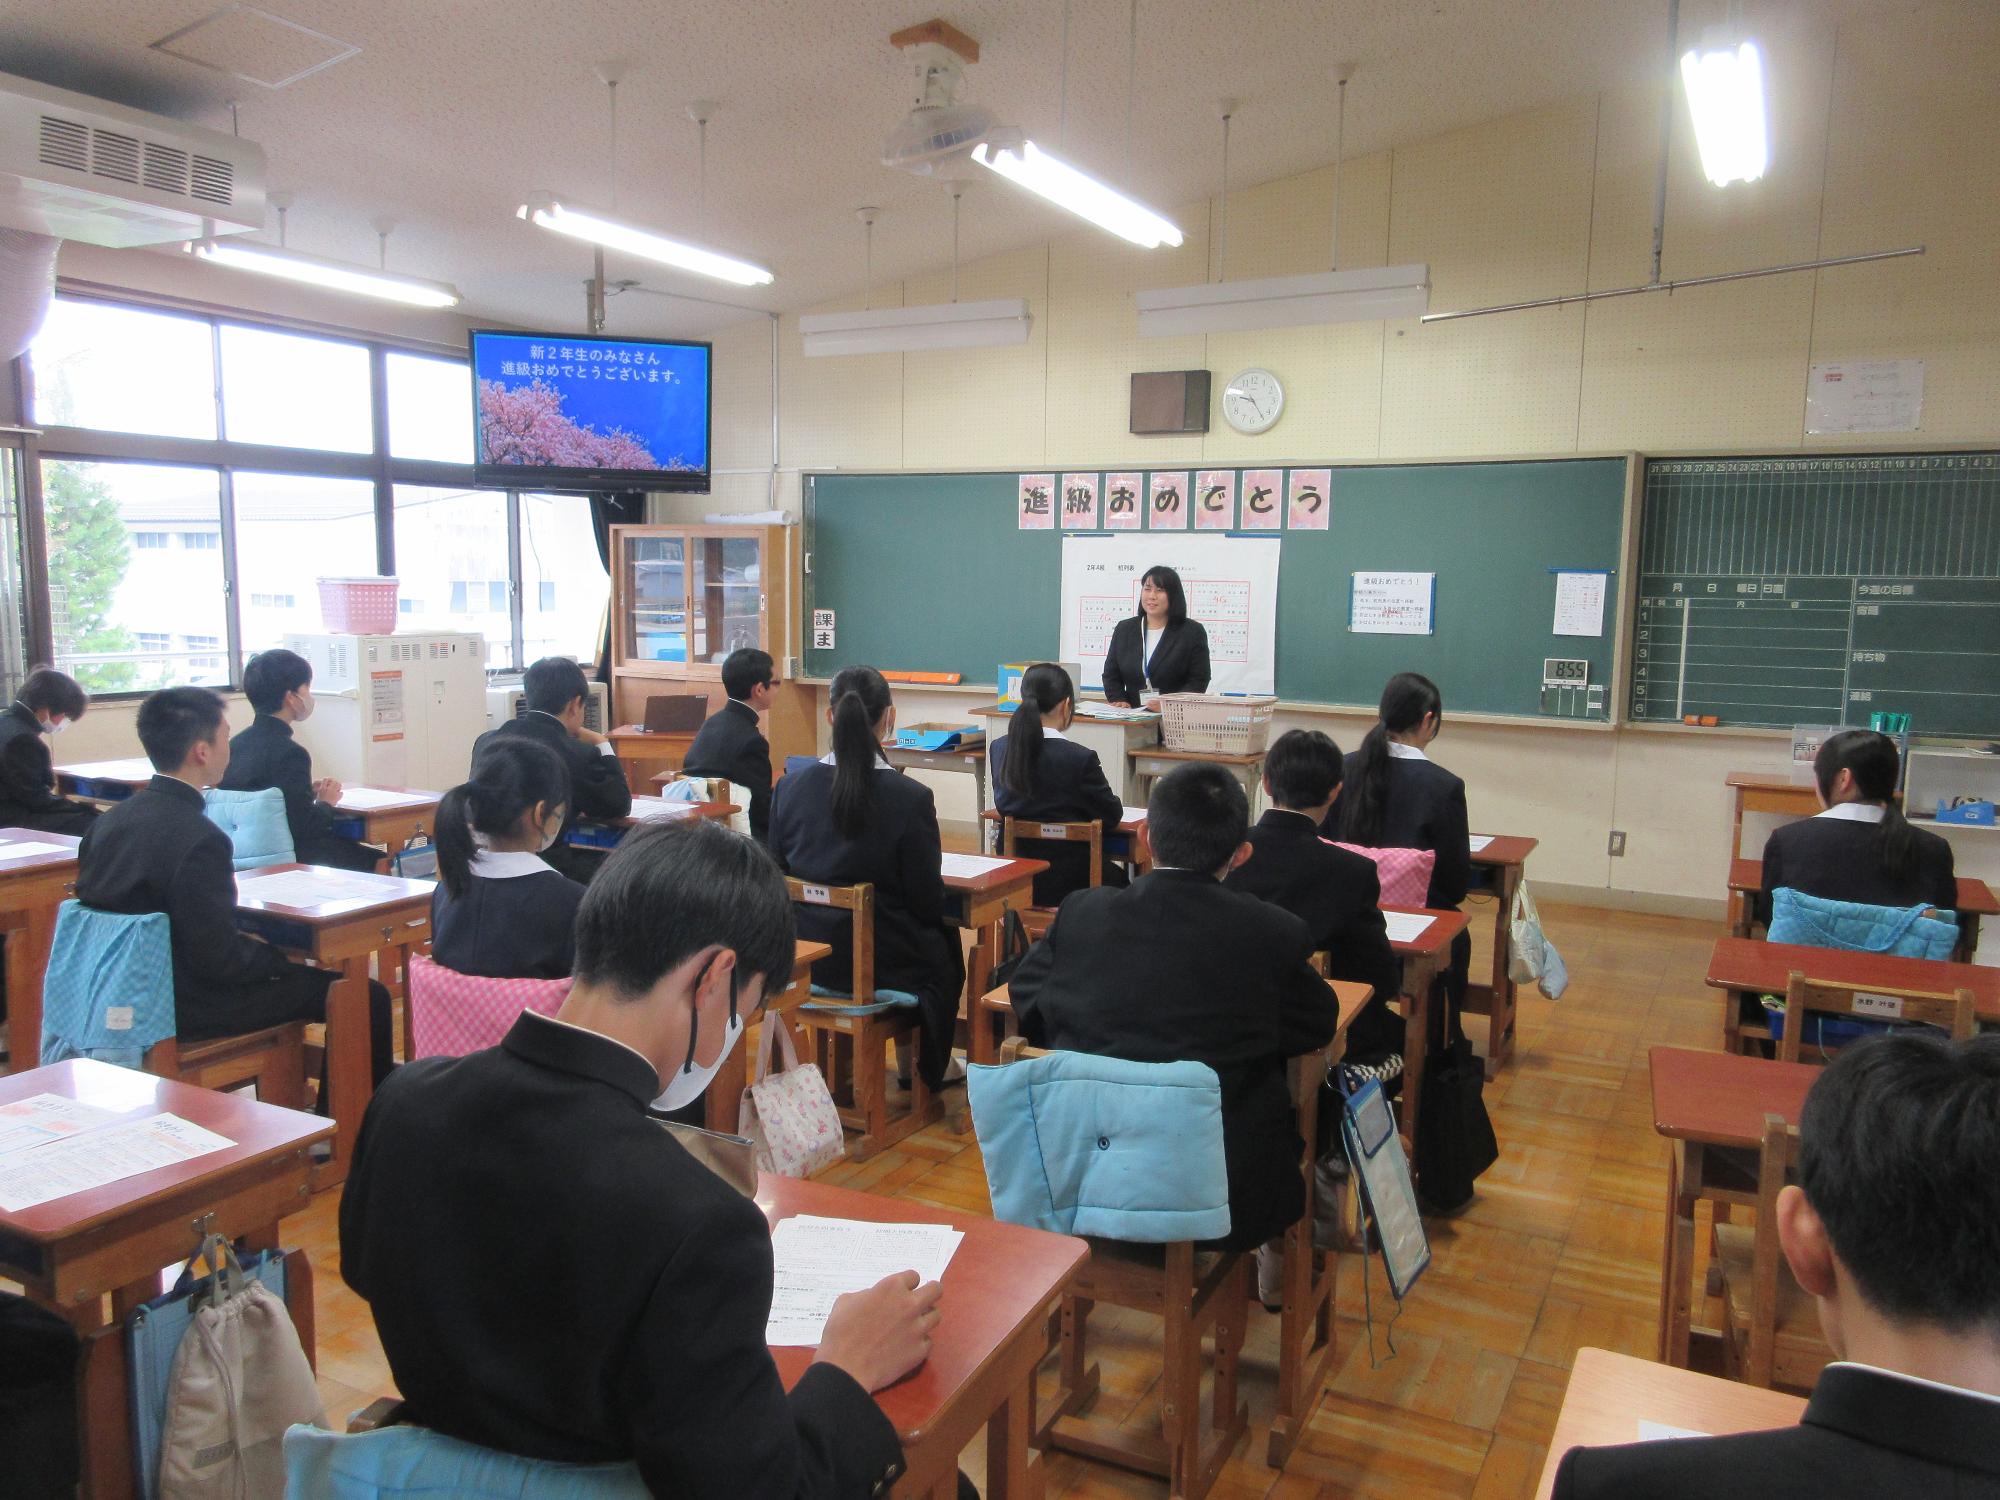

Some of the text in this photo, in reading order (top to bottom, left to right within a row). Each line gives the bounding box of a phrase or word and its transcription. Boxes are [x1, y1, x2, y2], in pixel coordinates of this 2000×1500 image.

[530, 344, 661, 366] 新2年生のみなさん
[501, 361, 681, 385] 進級おめでとうございます。
[1023, 485, 1322, 514] 進級おめでとう
[1673, 583, 1682, 592] 月
[1707, 584, 1716, 592] 日
[815, 613, 833, 626] 課
[817, 632, 831, 646] ま
[1640, 631, 1648, 639] 2
[1639, 649, 1647, 658] 3
[1638, 668, 1646, 676] 4
[1636, 686, 1645, 694] 5
[1635, 704, 1643, 712] 6
